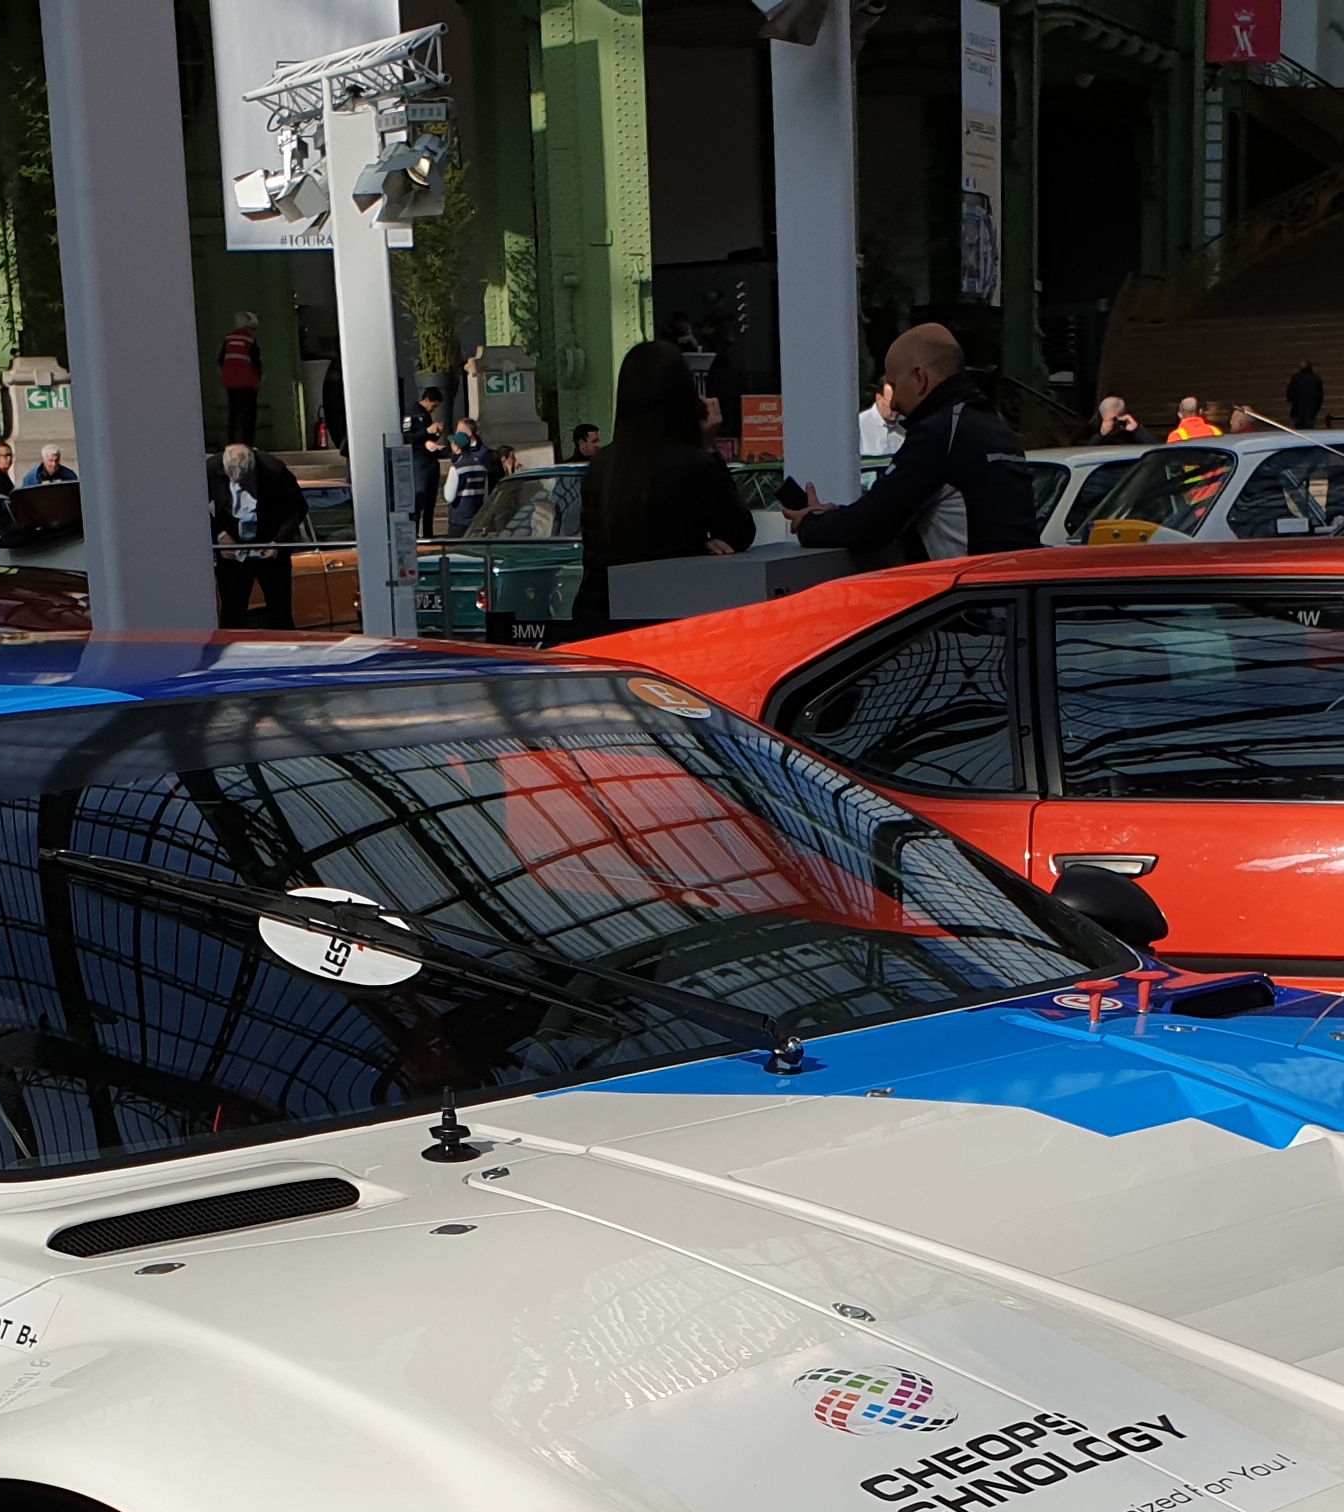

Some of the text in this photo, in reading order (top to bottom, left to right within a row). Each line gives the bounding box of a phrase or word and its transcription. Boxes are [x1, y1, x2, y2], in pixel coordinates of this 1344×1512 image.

[280, 233, 334, 247] #TOURA
[320, 936, 352, 977] LES
[16, 1325, 38, 1349] B+
[860, 1412, 1088, 1502] CHEOPS
[1186, 1476, 1234, 1501] For
[1229, 1453, 1298, 1486] You!
